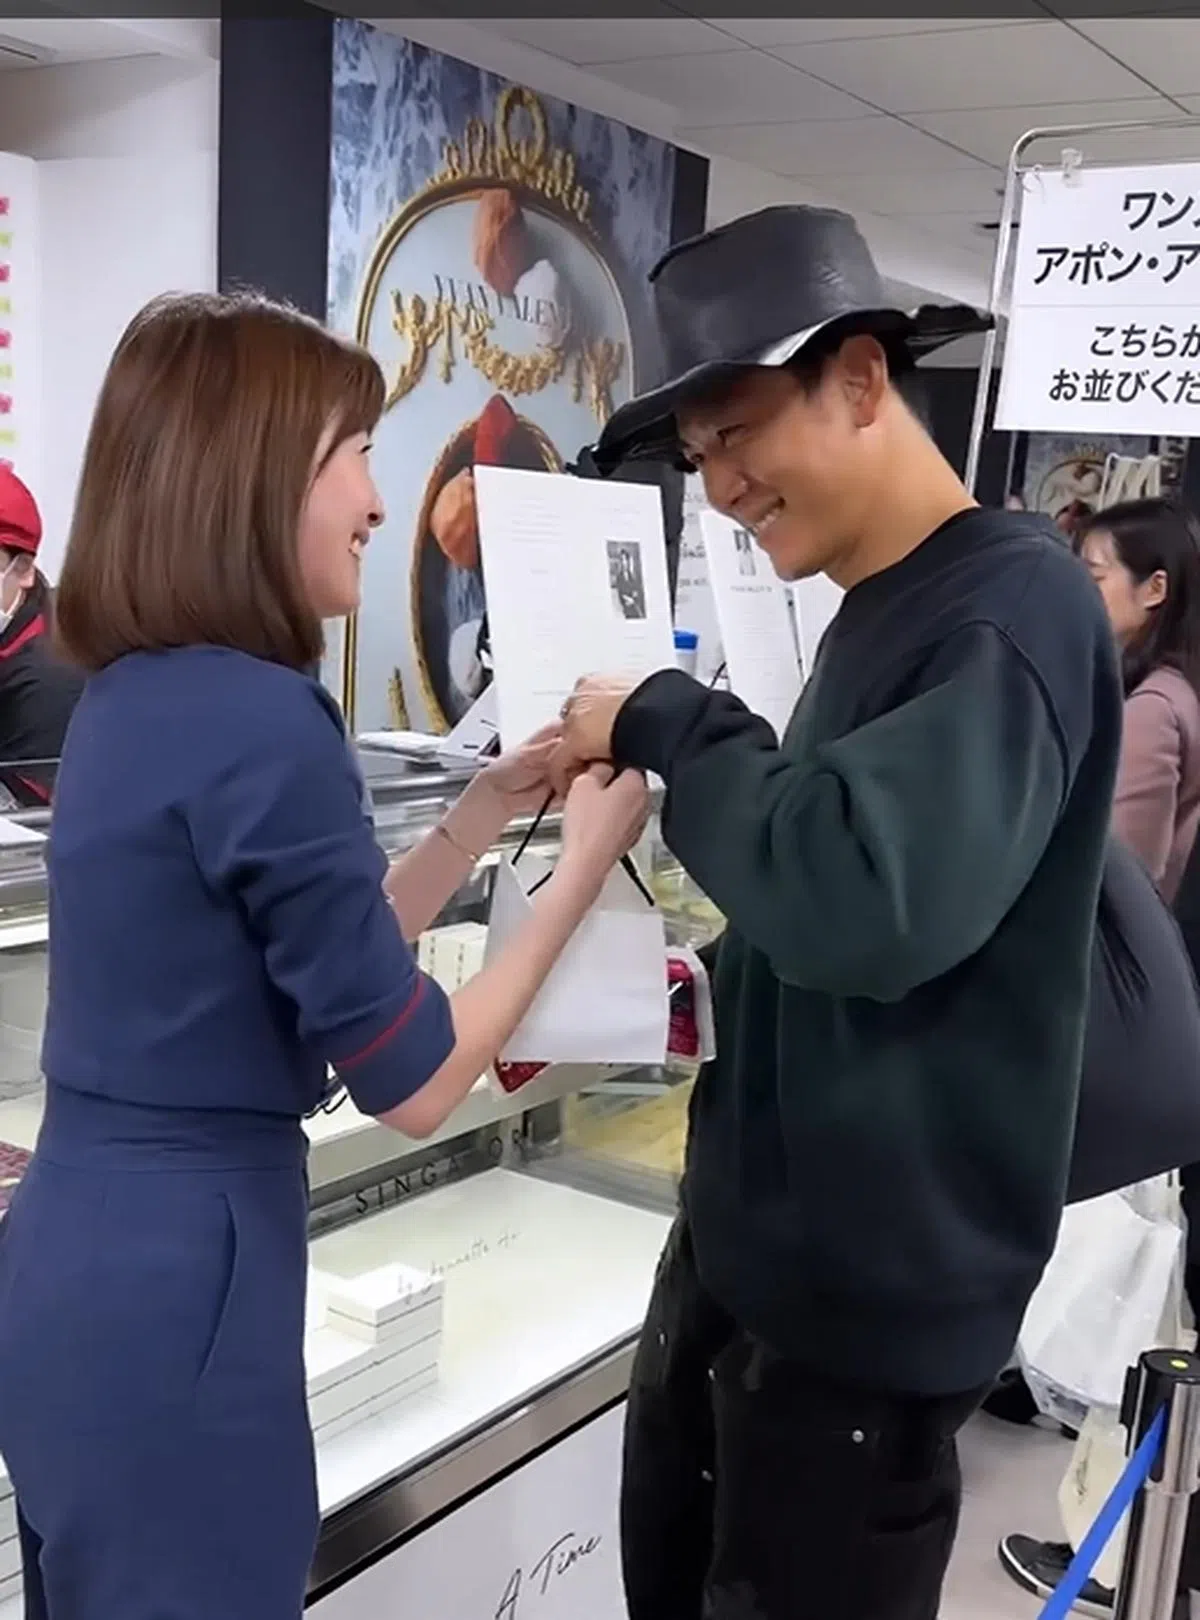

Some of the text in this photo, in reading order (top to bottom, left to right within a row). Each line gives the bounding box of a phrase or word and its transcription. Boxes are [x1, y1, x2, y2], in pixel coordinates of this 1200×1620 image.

[1123, 191, 1200, 231] ワン
[1034, 241, 1200, 286] アポン・ア
